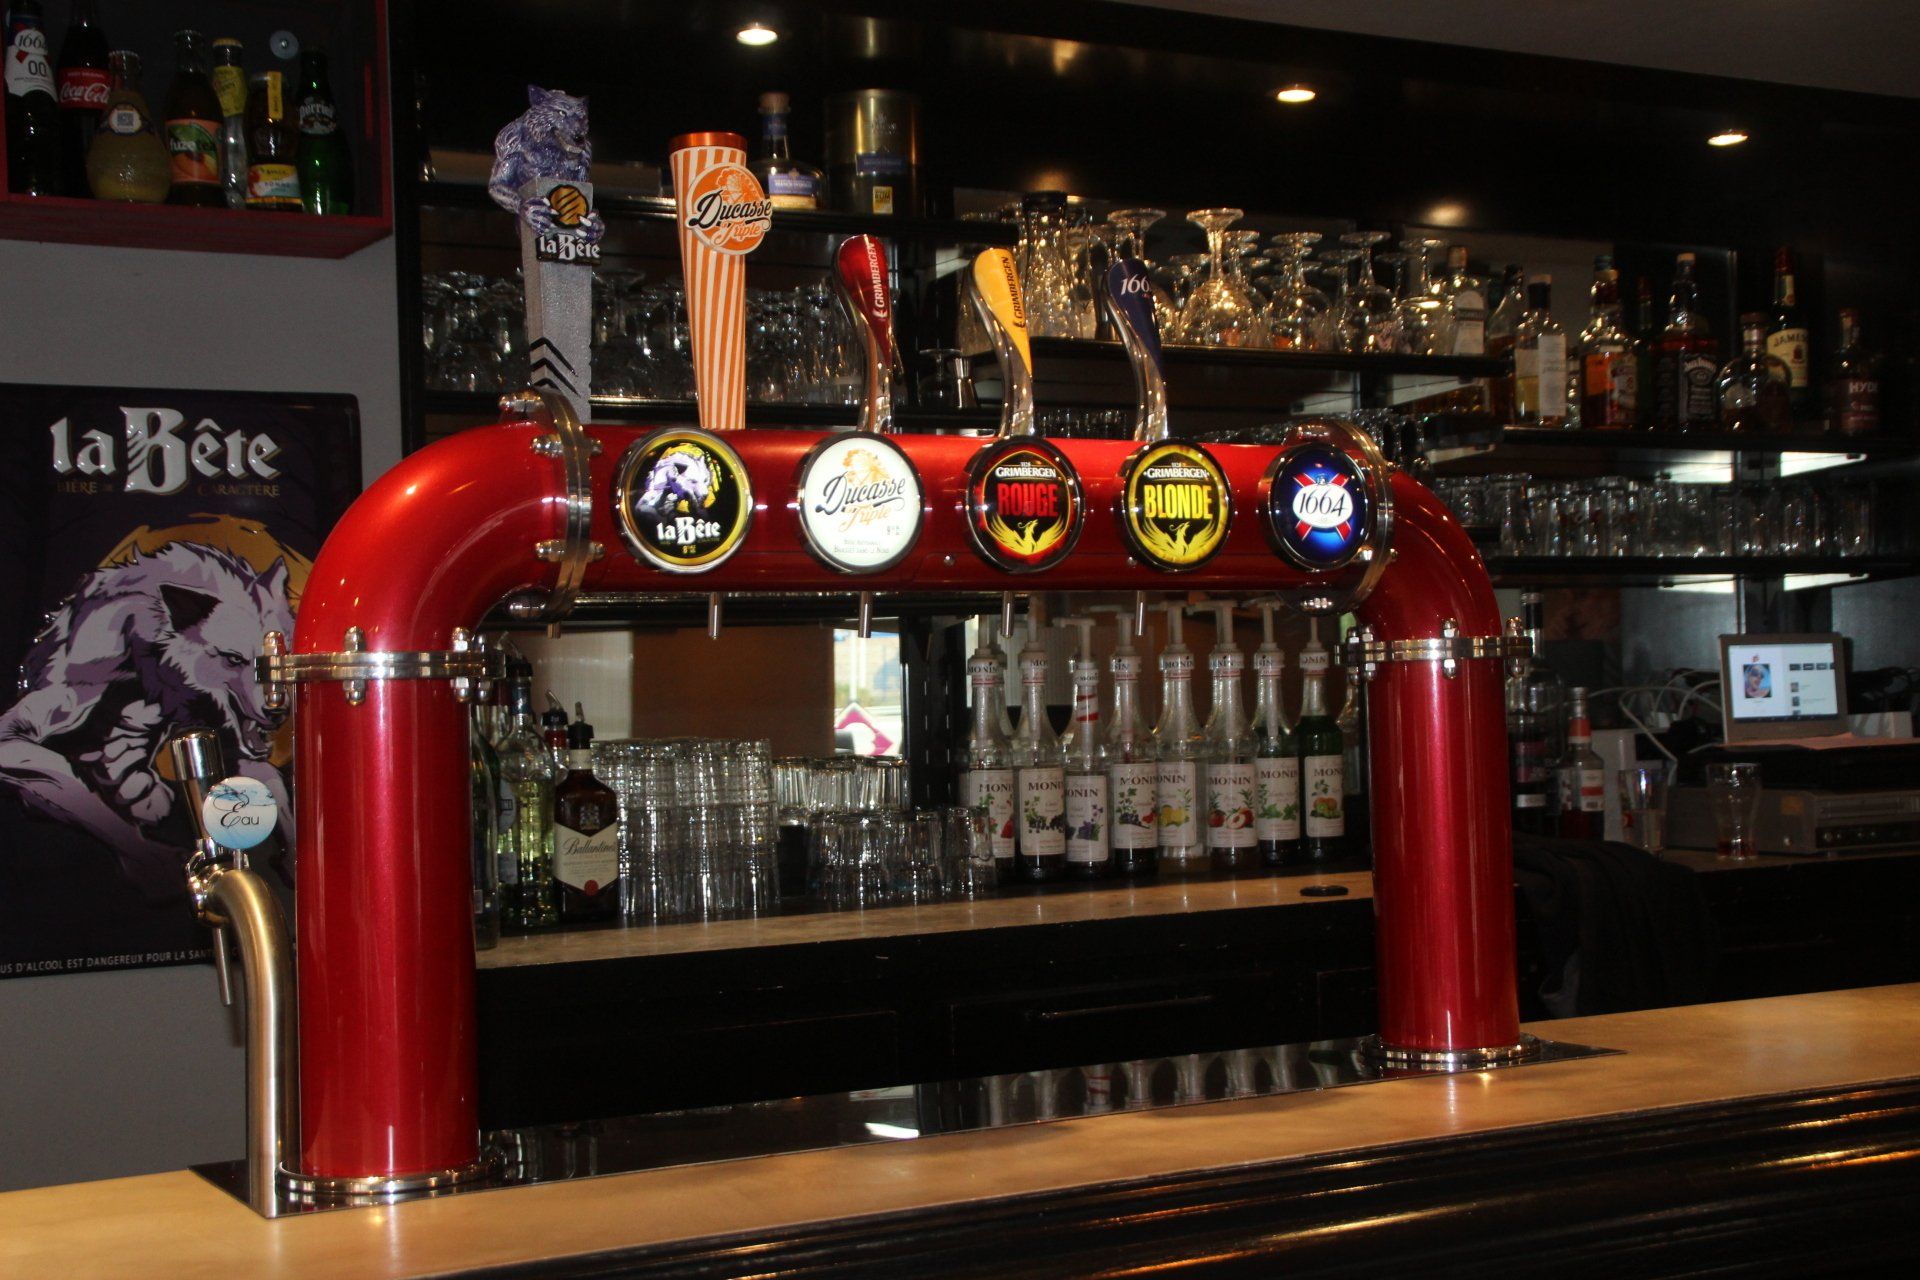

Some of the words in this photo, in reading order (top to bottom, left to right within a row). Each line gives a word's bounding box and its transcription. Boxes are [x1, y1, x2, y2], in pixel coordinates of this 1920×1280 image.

[18, 33, 45, 48] 166
[688, 190, 772, 229] Ducasse
[714, 220, 761, 245] Triple
[867, 243, 885, 308] GRIMBERGEN
[1001, 256, 1026, 320] GRIMBERGEN
[1120, 273, 1151, 295] 166
[50, 416, 118, 476] la
[120, 406, 283, 496] Bête
[995, 466, 1057, 478] GRIMBERGEN
[1146, 467, 1208, 479] GRIMBERGEN
[815, 471, 906, 516] Ducasse
[997, 482, 1059, 517] ROUGE
[1144, 483, 1214, 519] BLONDE
[1299, 488, 1348, 517] 1664
[675, 516, 721, 545] Bête
[1066, 788, 1099, 798] ONIN
[213, 792, 260, 829] Eau
[16, 960, 64, 973] D'ALCOOL
[67, 958, 84, 969] EST
[86, 953, 143, 967] DANGEREUX
[146, 951, 172, 962] POUR
[174, 949, 186, 961] LA
[188, 948, 215, 960] SANT
